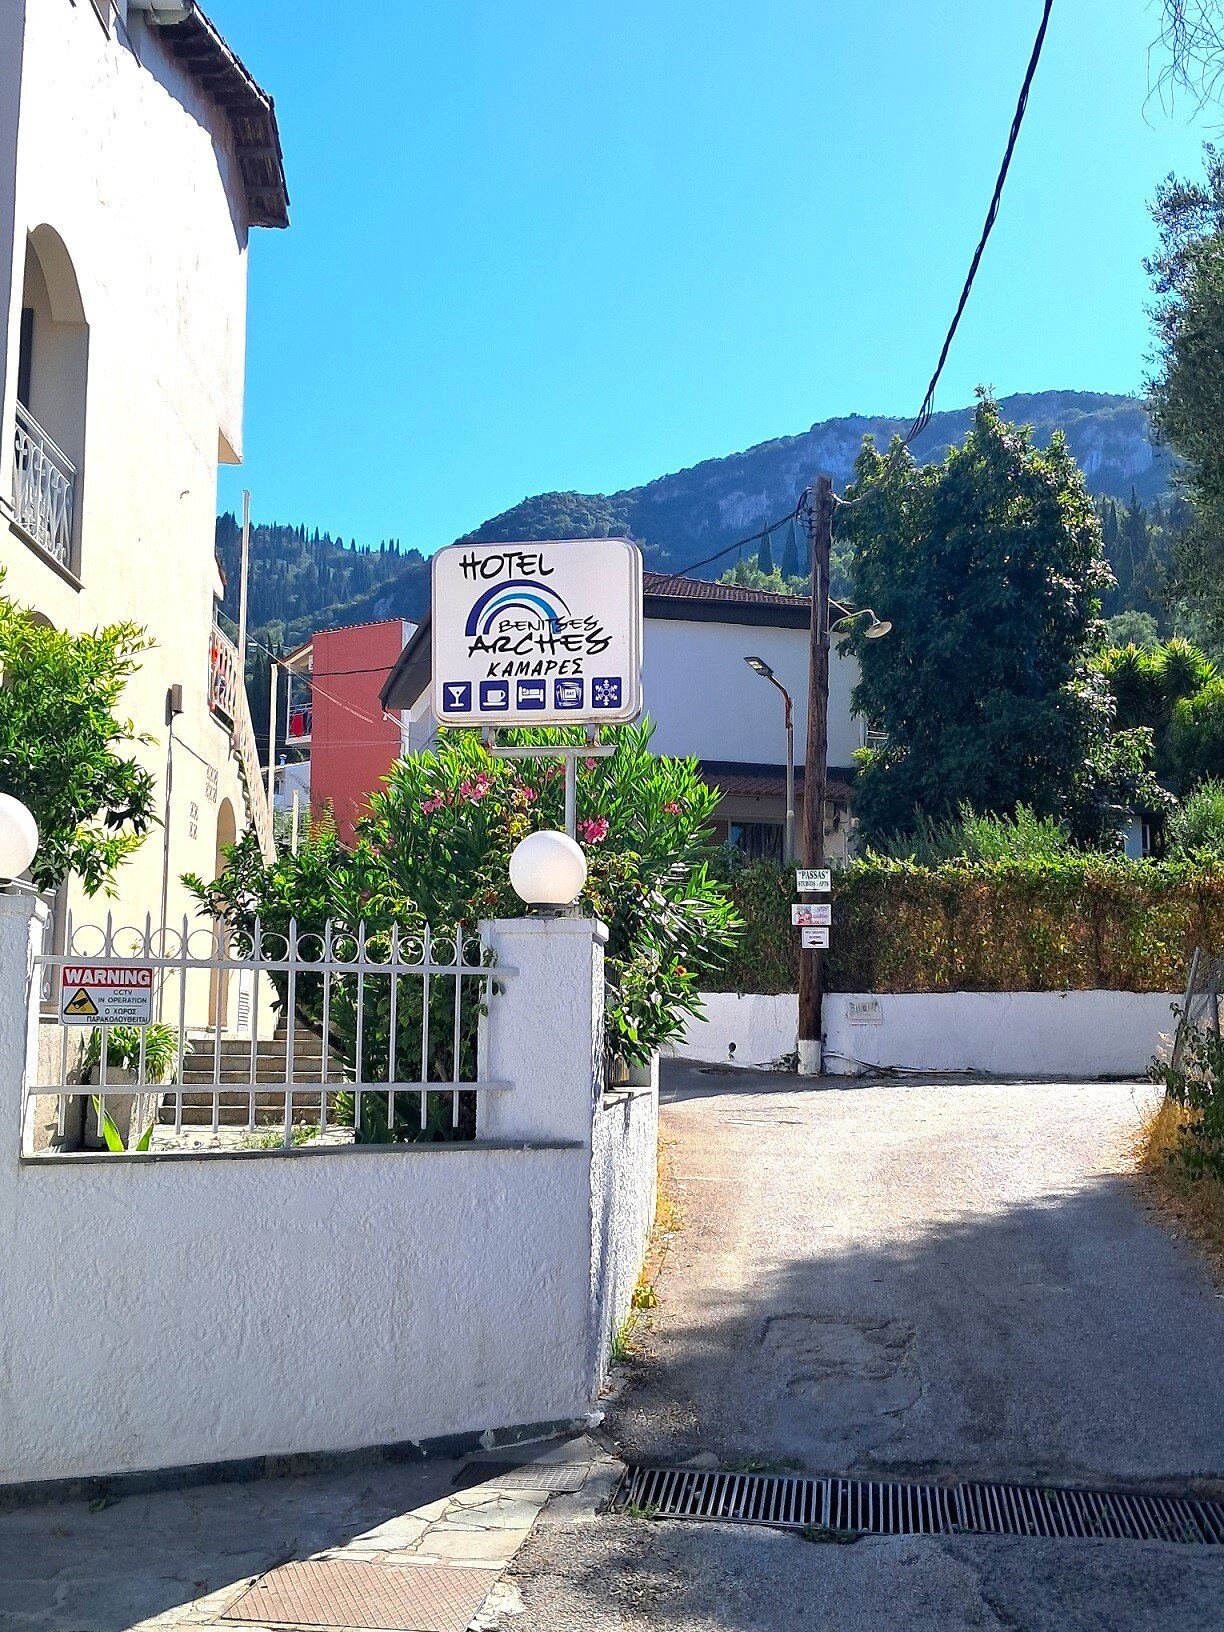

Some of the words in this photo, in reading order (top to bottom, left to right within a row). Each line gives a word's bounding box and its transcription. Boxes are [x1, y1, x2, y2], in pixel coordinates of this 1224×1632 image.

[459, 551, 555, 581] HOTEL
[498, 615, 600, 633] BENITSES
[467, 627, 613, 658] ARCHES
[486, 658, 584, 678] ΚΑΜΑΡΕΣ
[65, 968, 151, 985] WARNING
[86, 1015, 148, 1023] ΠΑΡΑΚΟΛΟΥΘΕΙΤΑΙ
